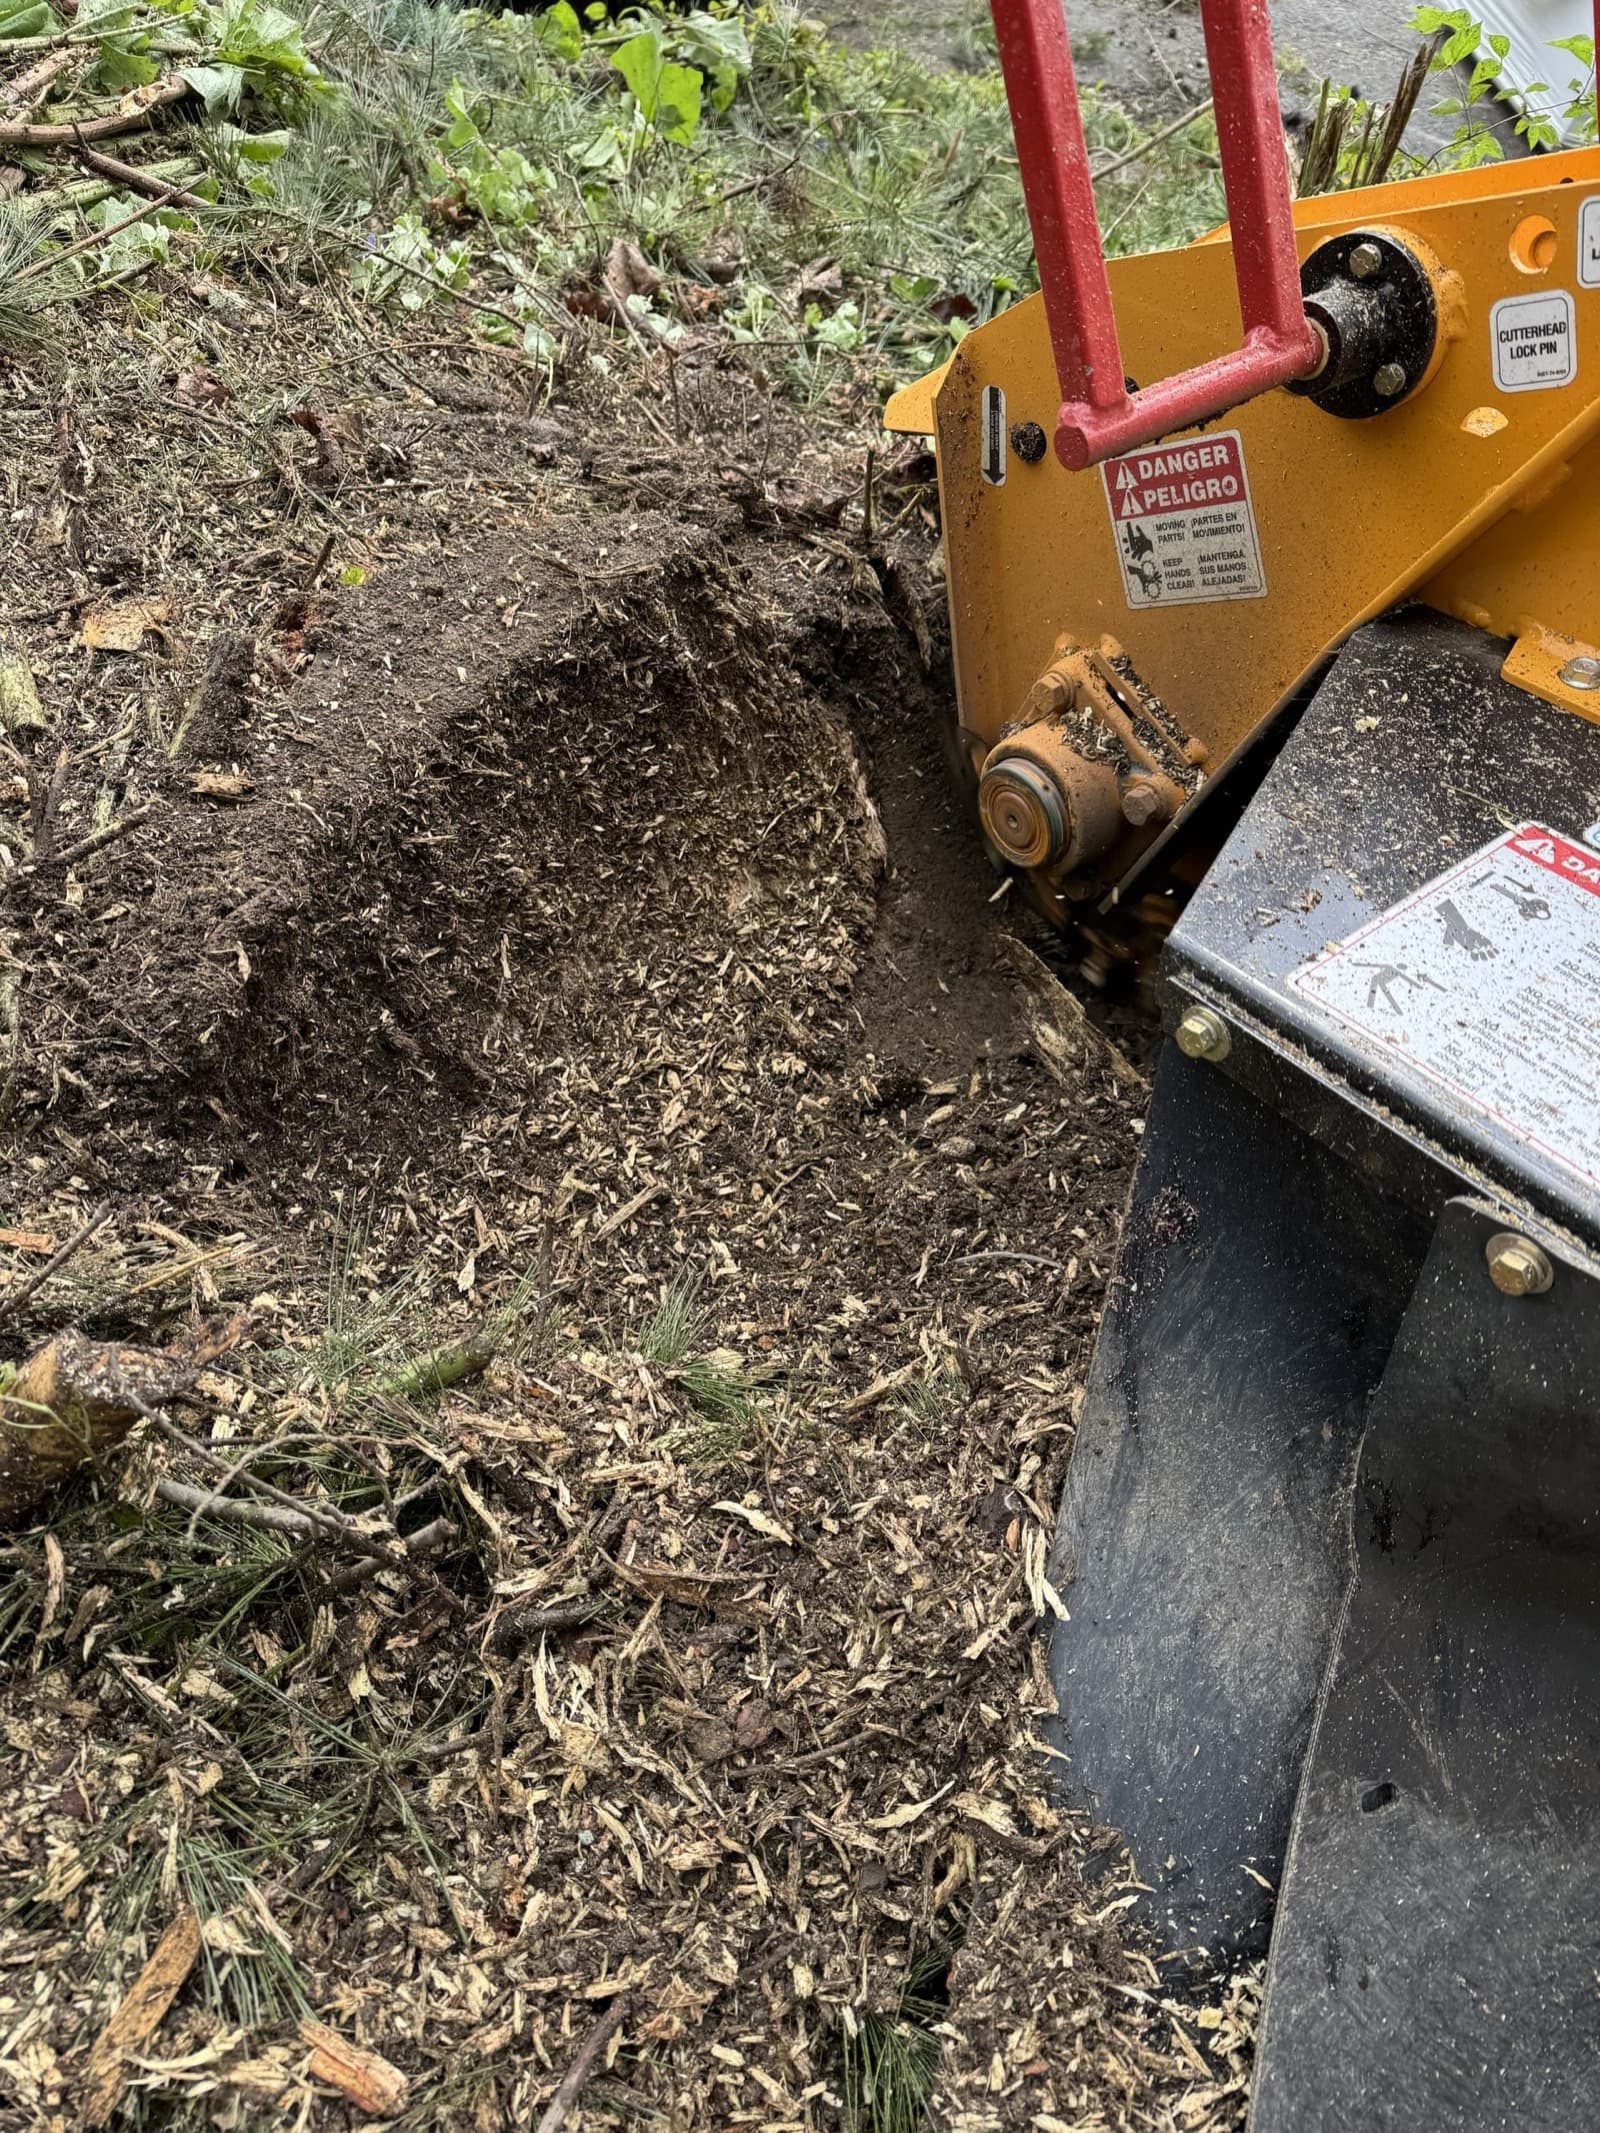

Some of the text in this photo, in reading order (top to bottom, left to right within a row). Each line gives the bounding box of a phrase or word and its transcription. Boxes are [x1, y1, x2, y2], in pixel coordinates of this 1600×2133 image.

[1499, 321, 1567, 343] CUTTERHEAD
[1510, 340, 1557, 360] LOCK PIN
[1137, 444, 1230, 480] DANGER
[1143, 474, 1238, 510] PELIGRO
[1225, 512, 1237, 522] EN
[1155, 519, 1186, 532] MOVING
[1192, 523, 1245, 539] MOVIMIENTO!
[1157, 532, 1185, 544] PARTS!
[1162, 557, 1183, 568] KEEP
[1199, 561, 1247, 575] SUS MANOS
[1164, 568, 1192, 579] HANDS
[1167, 579, 1195, 590] CLEAR!
[1202, 574, 1246, 587] ALEJADAS!
[1524, 986, 1543, 999] NO
